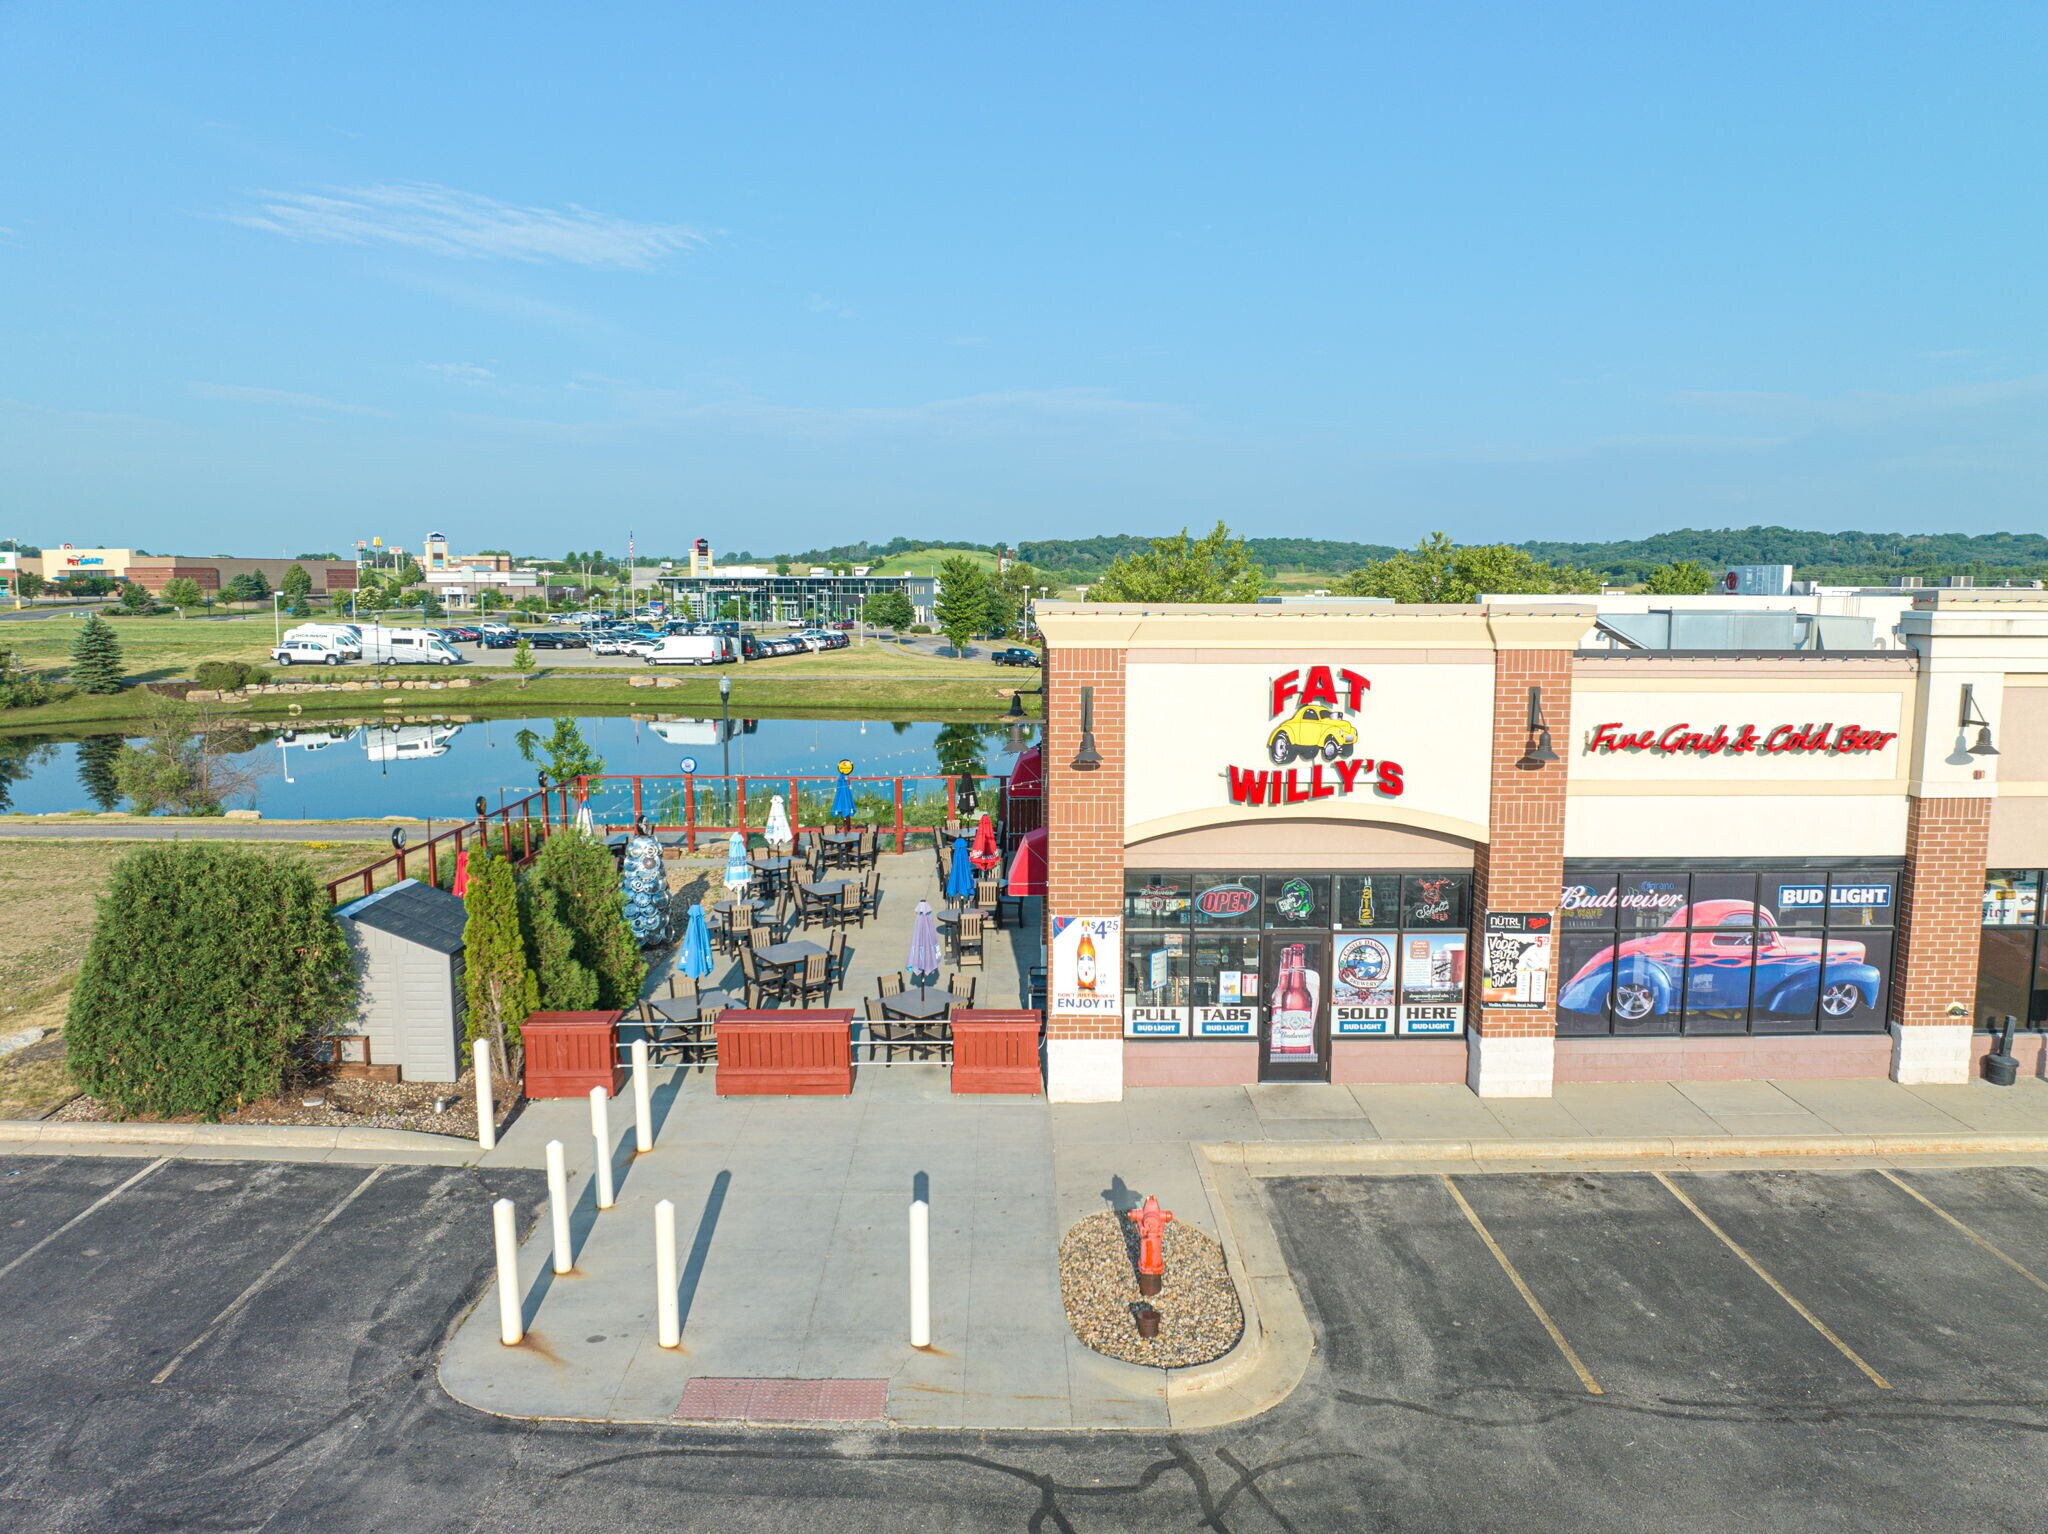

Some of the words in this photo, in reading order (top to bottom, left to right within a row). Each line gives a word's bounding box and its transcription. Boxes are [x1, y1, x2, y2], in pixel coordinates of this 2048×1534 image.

[1273, 666, 1371, 716] FAT
[1591, 722, 1655, 752] Fine
[1657, 723, 1728, 754] Grub
[1732, 724, 1761, 751] &
[1767, 722, 1835, 752] Cold
[1837, 725, 1897, 752] Beer
[1229, 759, 1404, 804] WILLY'S
[1202, 891, 1251, 912] OPEN
[1558, 885, 1684, 909] Budweiser
[1782, 889, 1824, 904] BUD
[1830, 888, 1887, 903] LIGHT
[1492, 960, 1518, 974] REAL
[1492, 972, 1517, 988] JUICE
[1057, 998, 1100, 1009] ENJOY
[1104, 999, 1116, 1009] IT
[1132, 1009, 1181, 1021] PULL
[1200, 1009, 1251, 1021] TABS
[1338, 1007, 1389, 1020] SOLD
[1406, 1007, 1457, 1020] HERE
